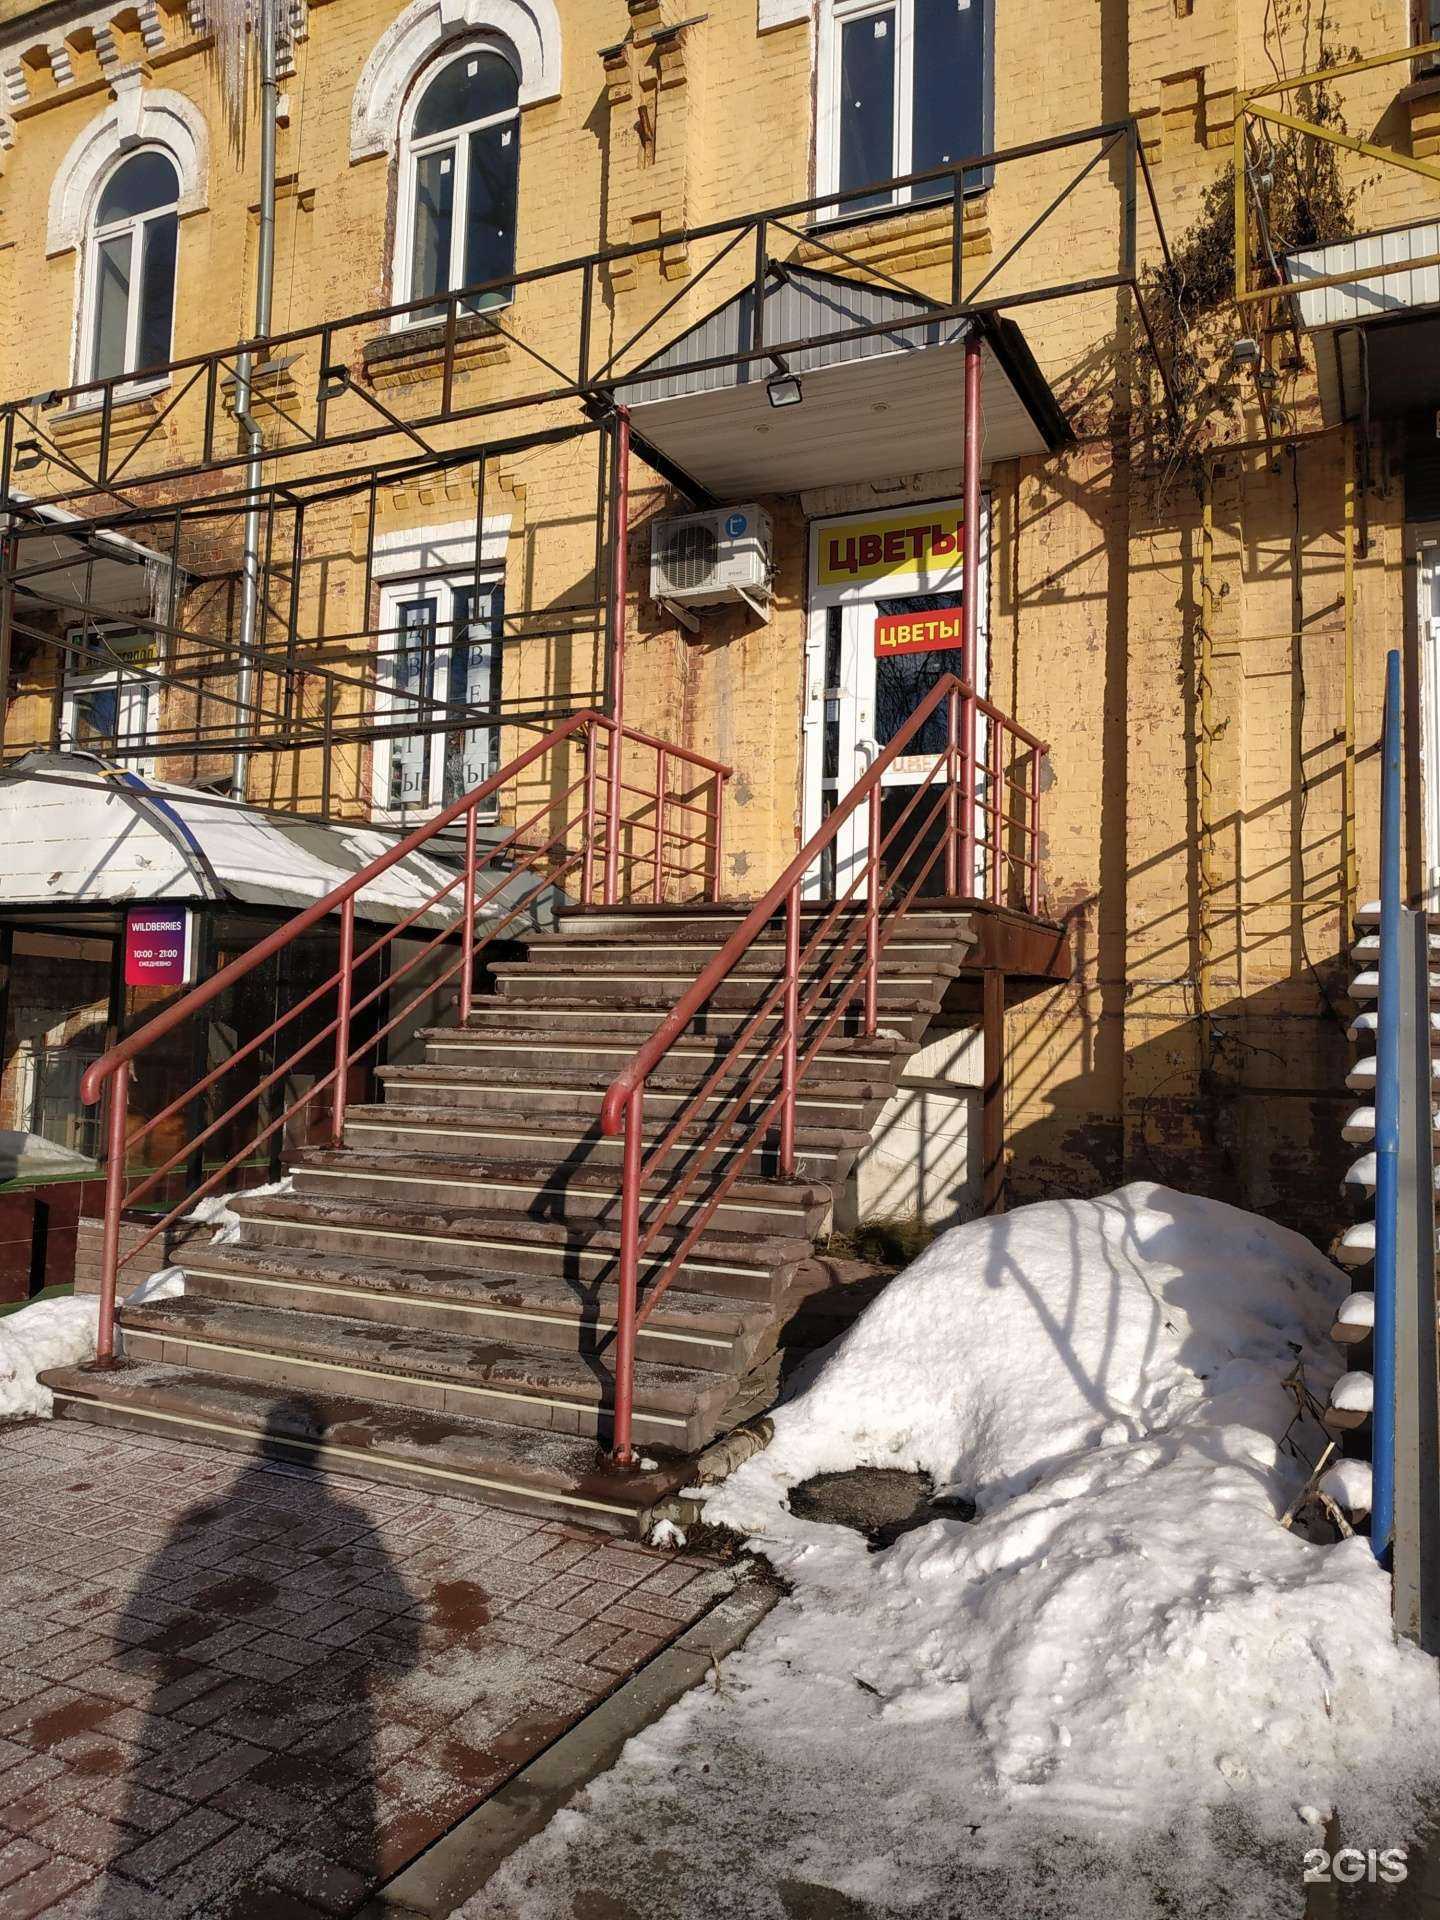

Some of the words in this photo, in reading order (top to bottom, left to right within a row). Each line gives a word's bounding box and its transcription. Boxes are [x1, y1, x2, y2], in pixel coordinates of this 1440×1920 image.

[829, 520, 965, 573] ЦВЕТЫ
[879, 618, 960, 647] ЦВЕТЫ
[131, 921, 182, 932] WILDBERRIES
[133, 950, 153, 958] 10:00
[158, 950, 178, 958] 21:00
